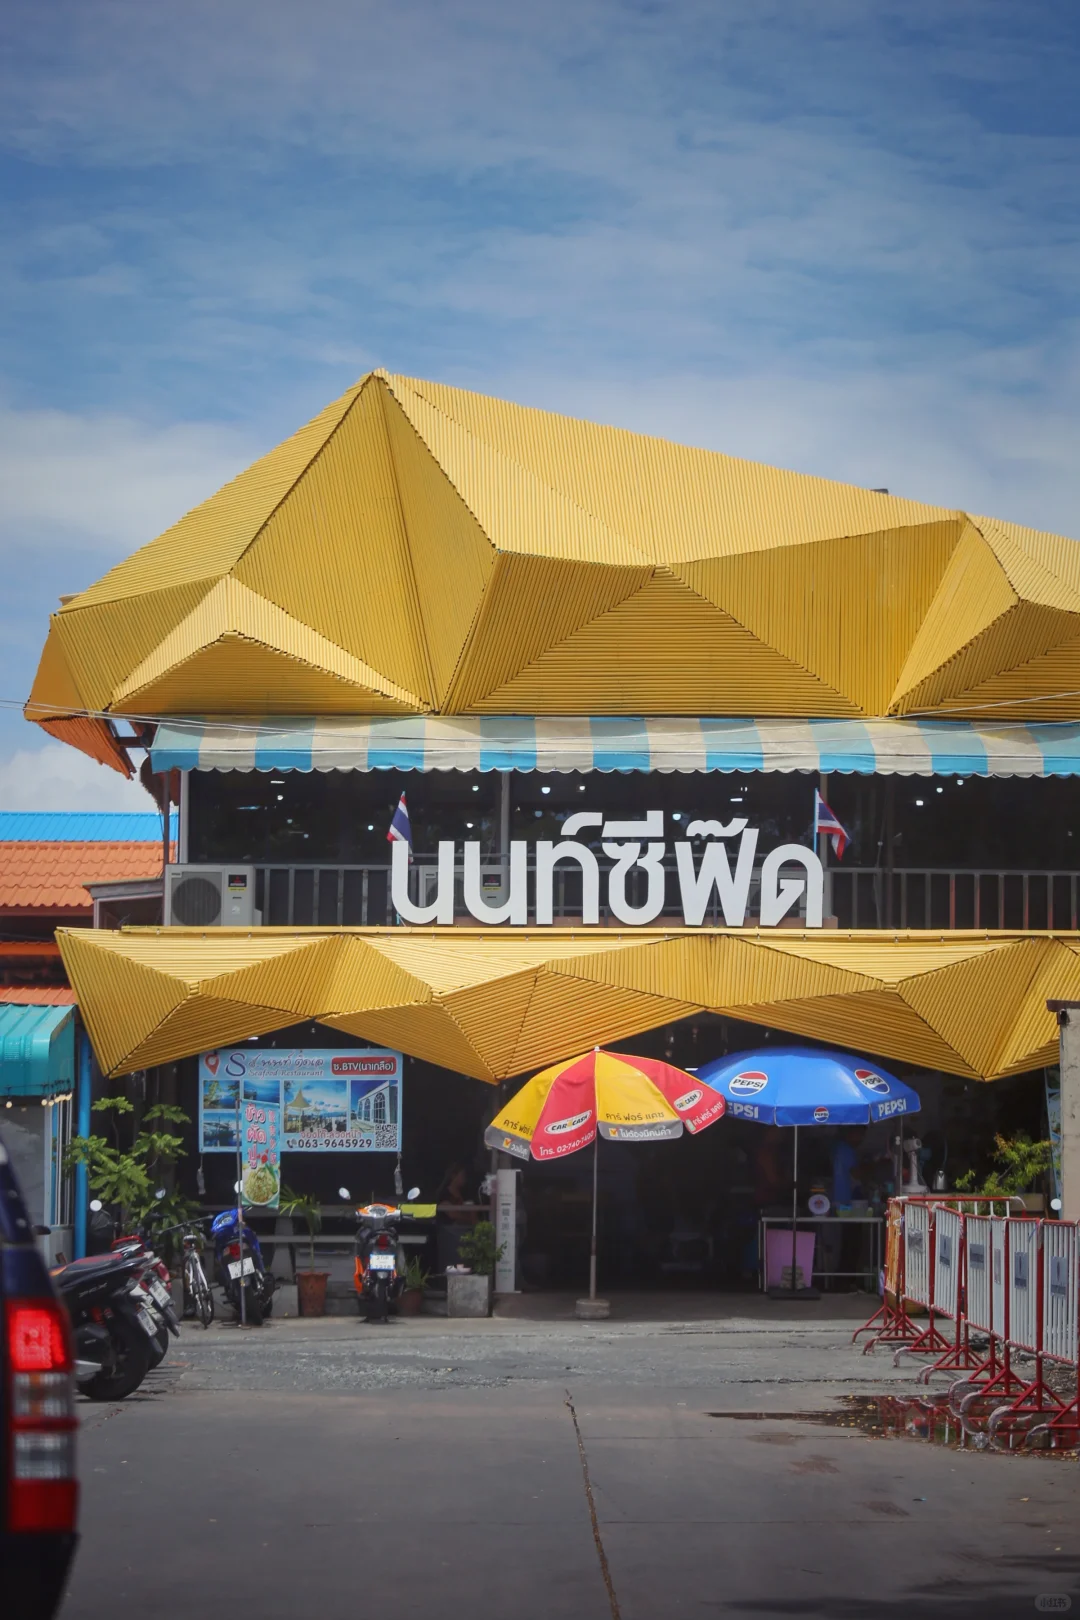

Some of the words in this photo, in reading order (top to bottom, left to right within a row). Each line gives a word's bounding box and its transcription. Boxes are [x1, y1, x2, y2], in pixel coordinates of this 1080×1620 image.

[248, 1068, 278, 1079] Seafood
[281, 1068, 324, 1077] Restaurant
[733, 1078, 765, 1088] PEPSI
[878, 1098, 907, 1117] PEPSI
[298, 1139, 372, 1148] 063-9645929
